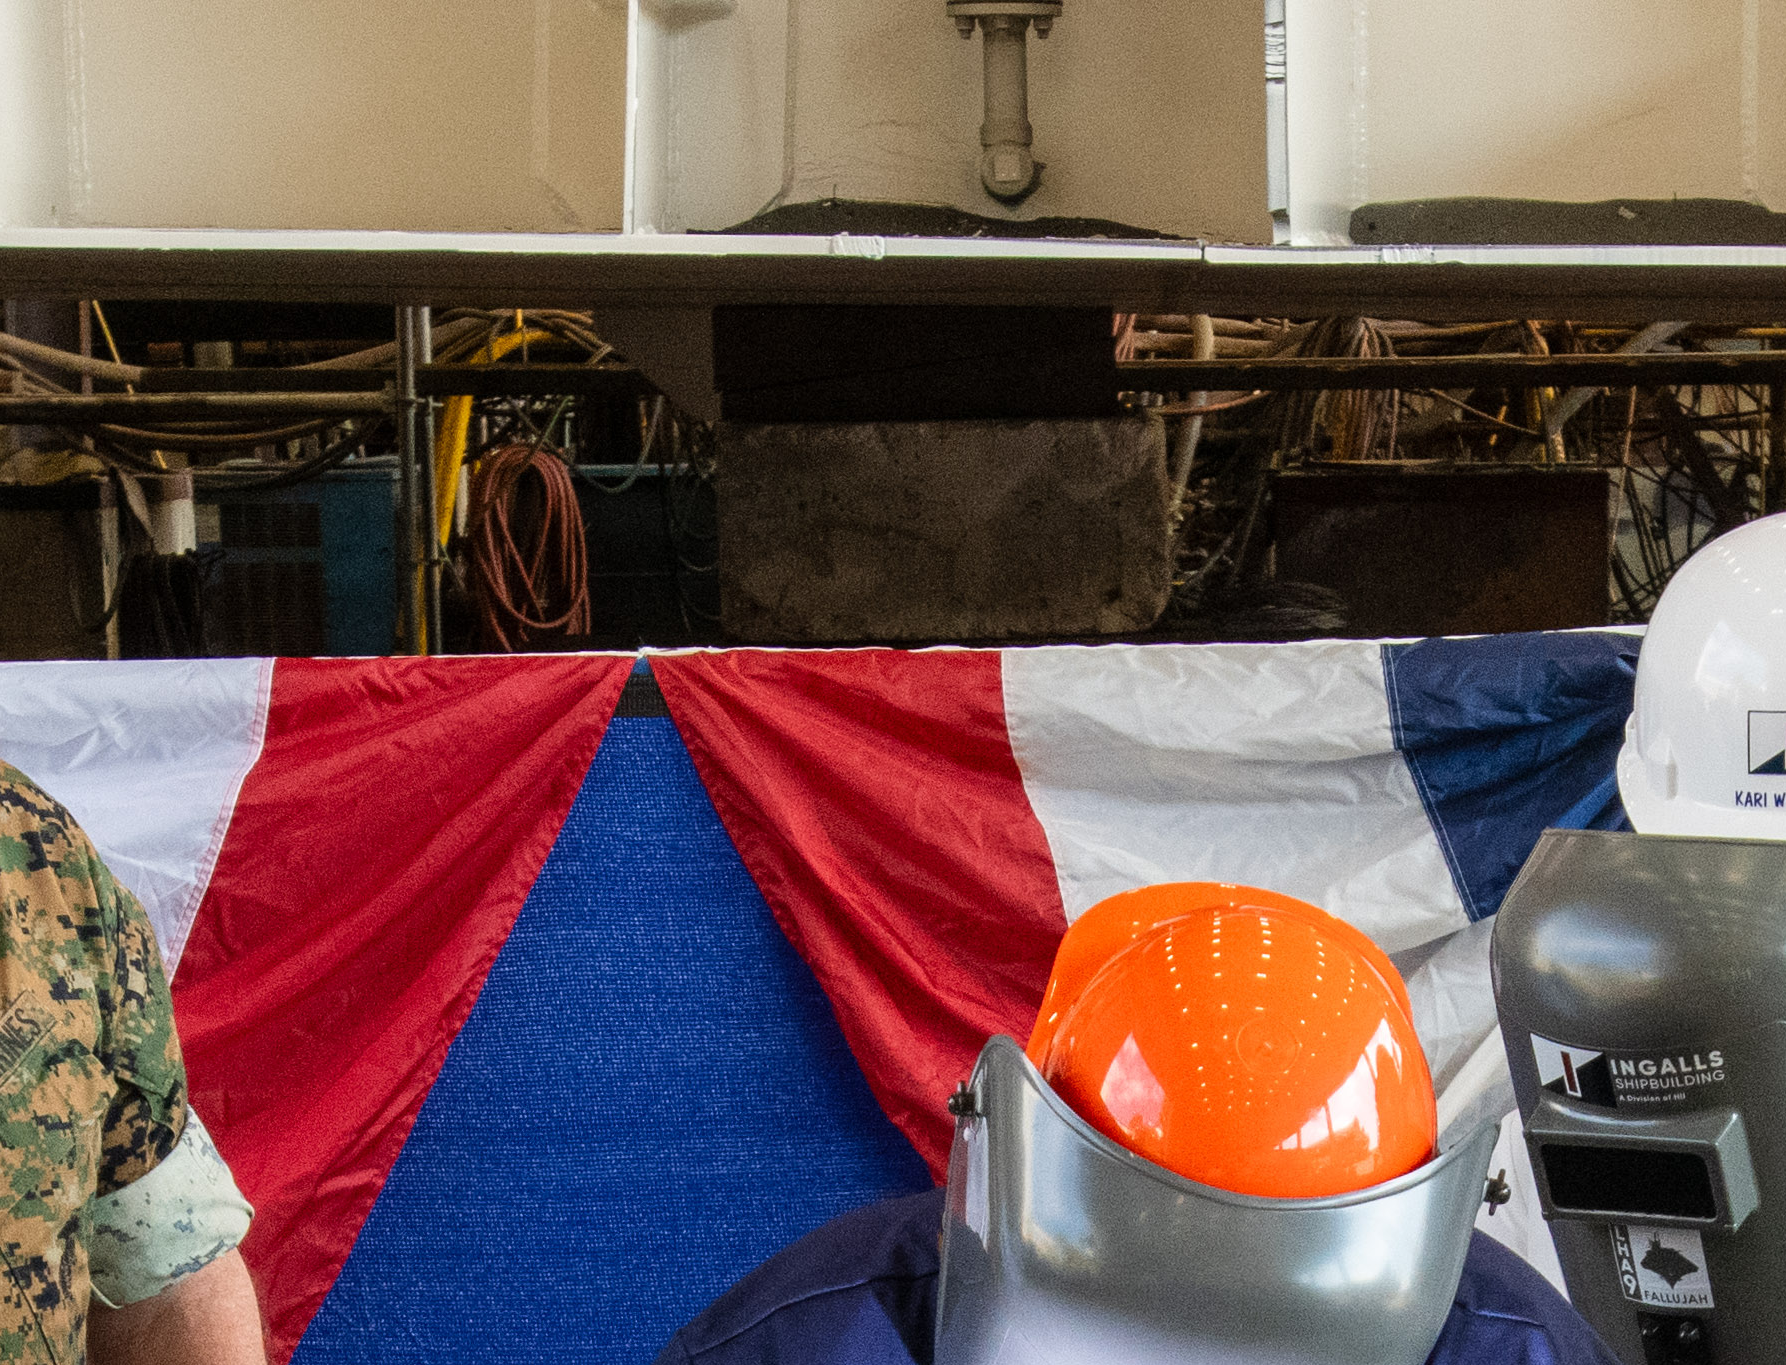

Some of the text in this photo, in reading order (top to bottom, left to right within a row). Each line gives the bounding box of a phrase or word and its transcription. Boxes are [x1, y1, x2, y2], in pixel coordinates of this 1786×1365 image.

[1735, 790, 1767, 808] KARI
[1610, 1050, 1724, 1076] INGALLS
[1615, 1069, 1725, 1089] SHIPBUILDING
[1626, 1094, 1661, 1102] Division
[1616, 1226, 1637, 1296] LHA9
[1644, 1290, 1708, 1304] FALLUJAH
